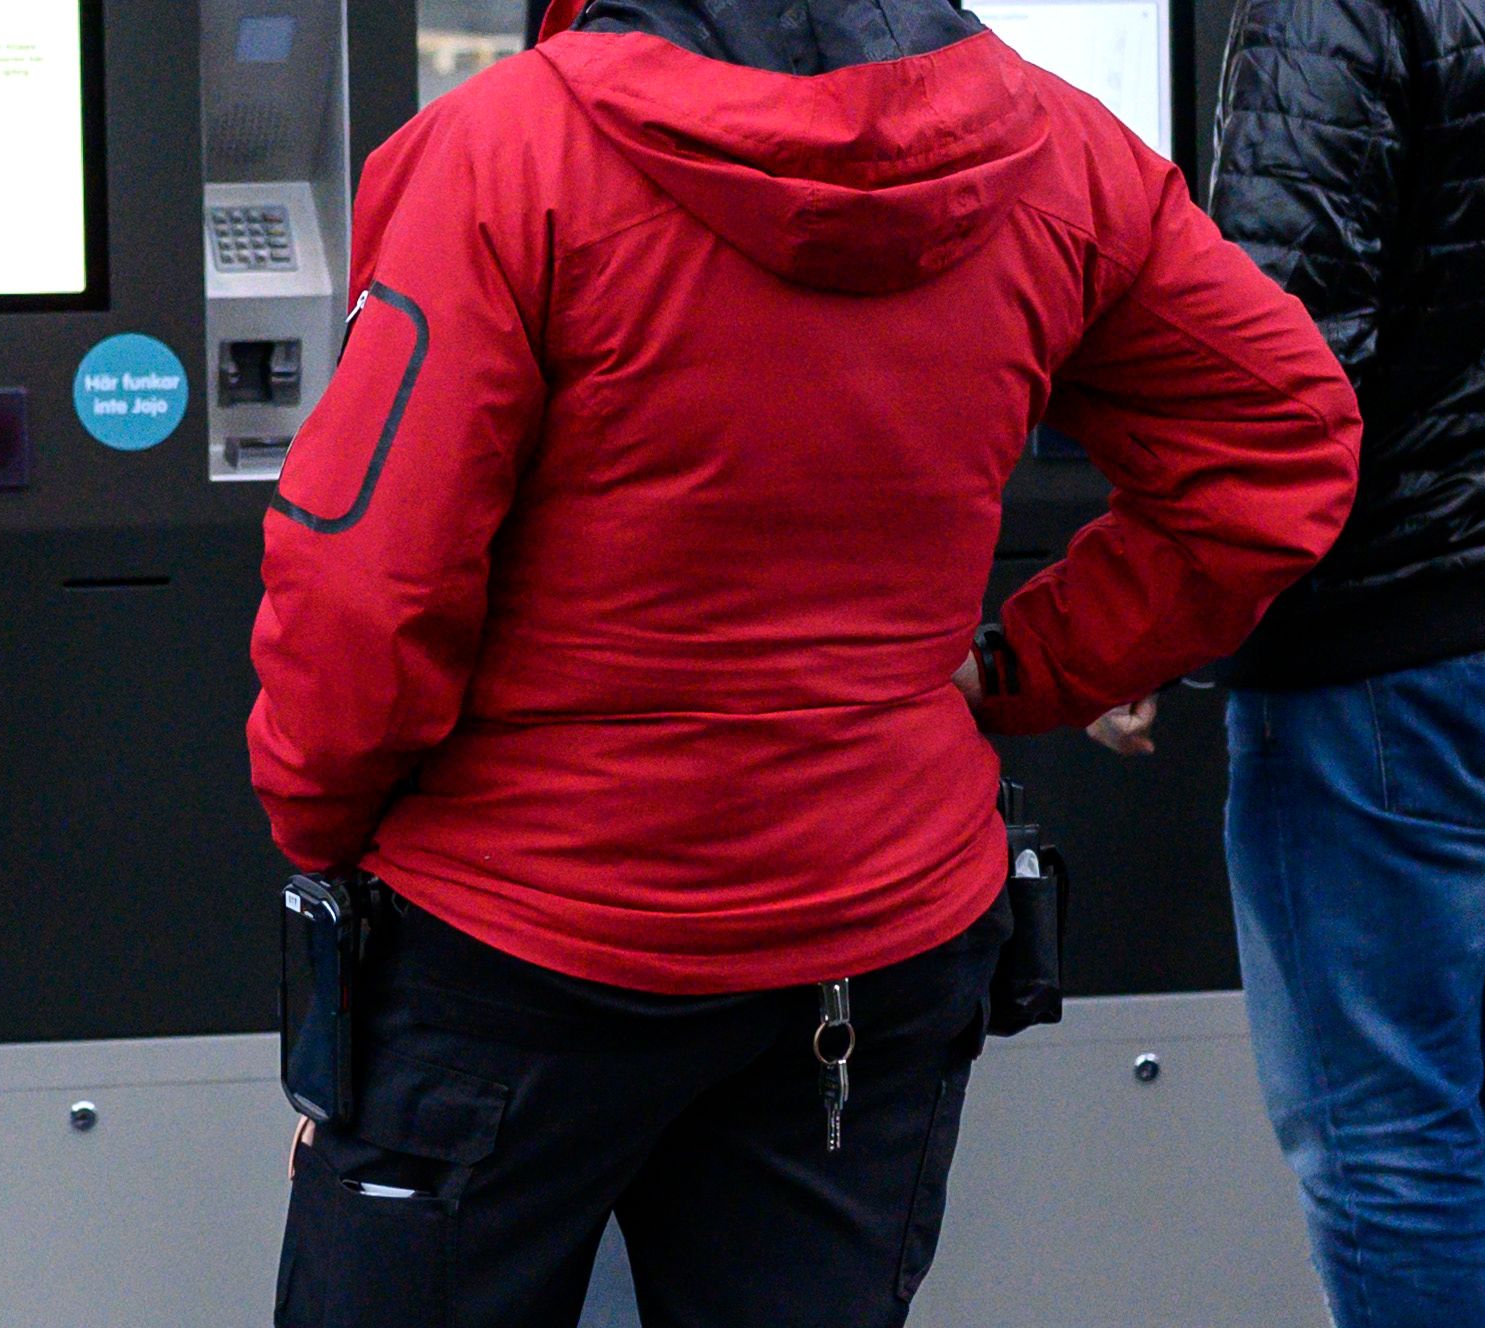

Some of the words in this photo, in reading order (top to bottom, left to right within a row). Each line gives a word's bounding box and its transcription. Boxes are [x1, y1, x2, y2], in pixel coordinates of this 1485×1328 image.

[121, 371, 181, 392] funkar
[92, 397, 129, 415] inte
[131, 395, 170, 418] Jojo
